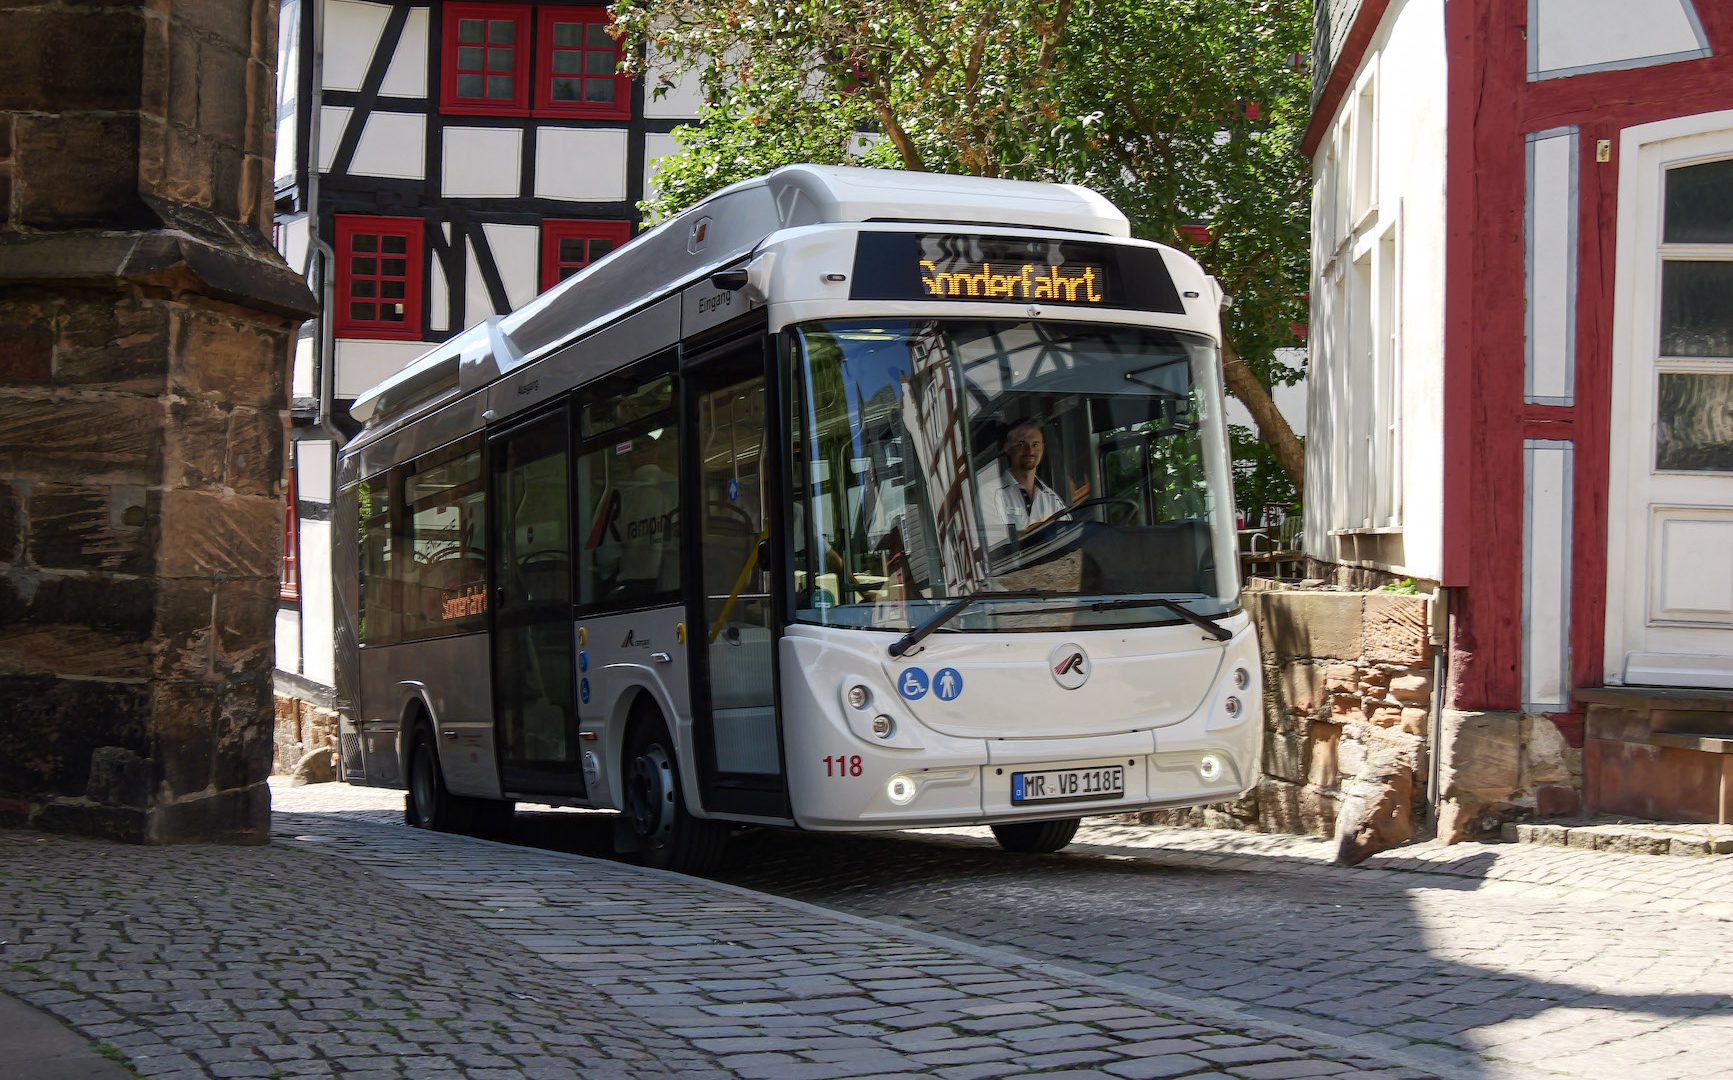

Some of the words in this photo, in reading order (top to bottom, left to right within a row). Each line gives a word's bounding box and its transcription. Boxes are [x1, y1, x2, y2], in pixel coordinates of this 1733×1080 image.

[698, 290, 731, 314] Eingang
[822, 755, 863, 777] 118
[1024, 775, 1046, 797] MR
[1058, 773, 1078, 795] VB
[1082, 769, 1121, 793] 118E
